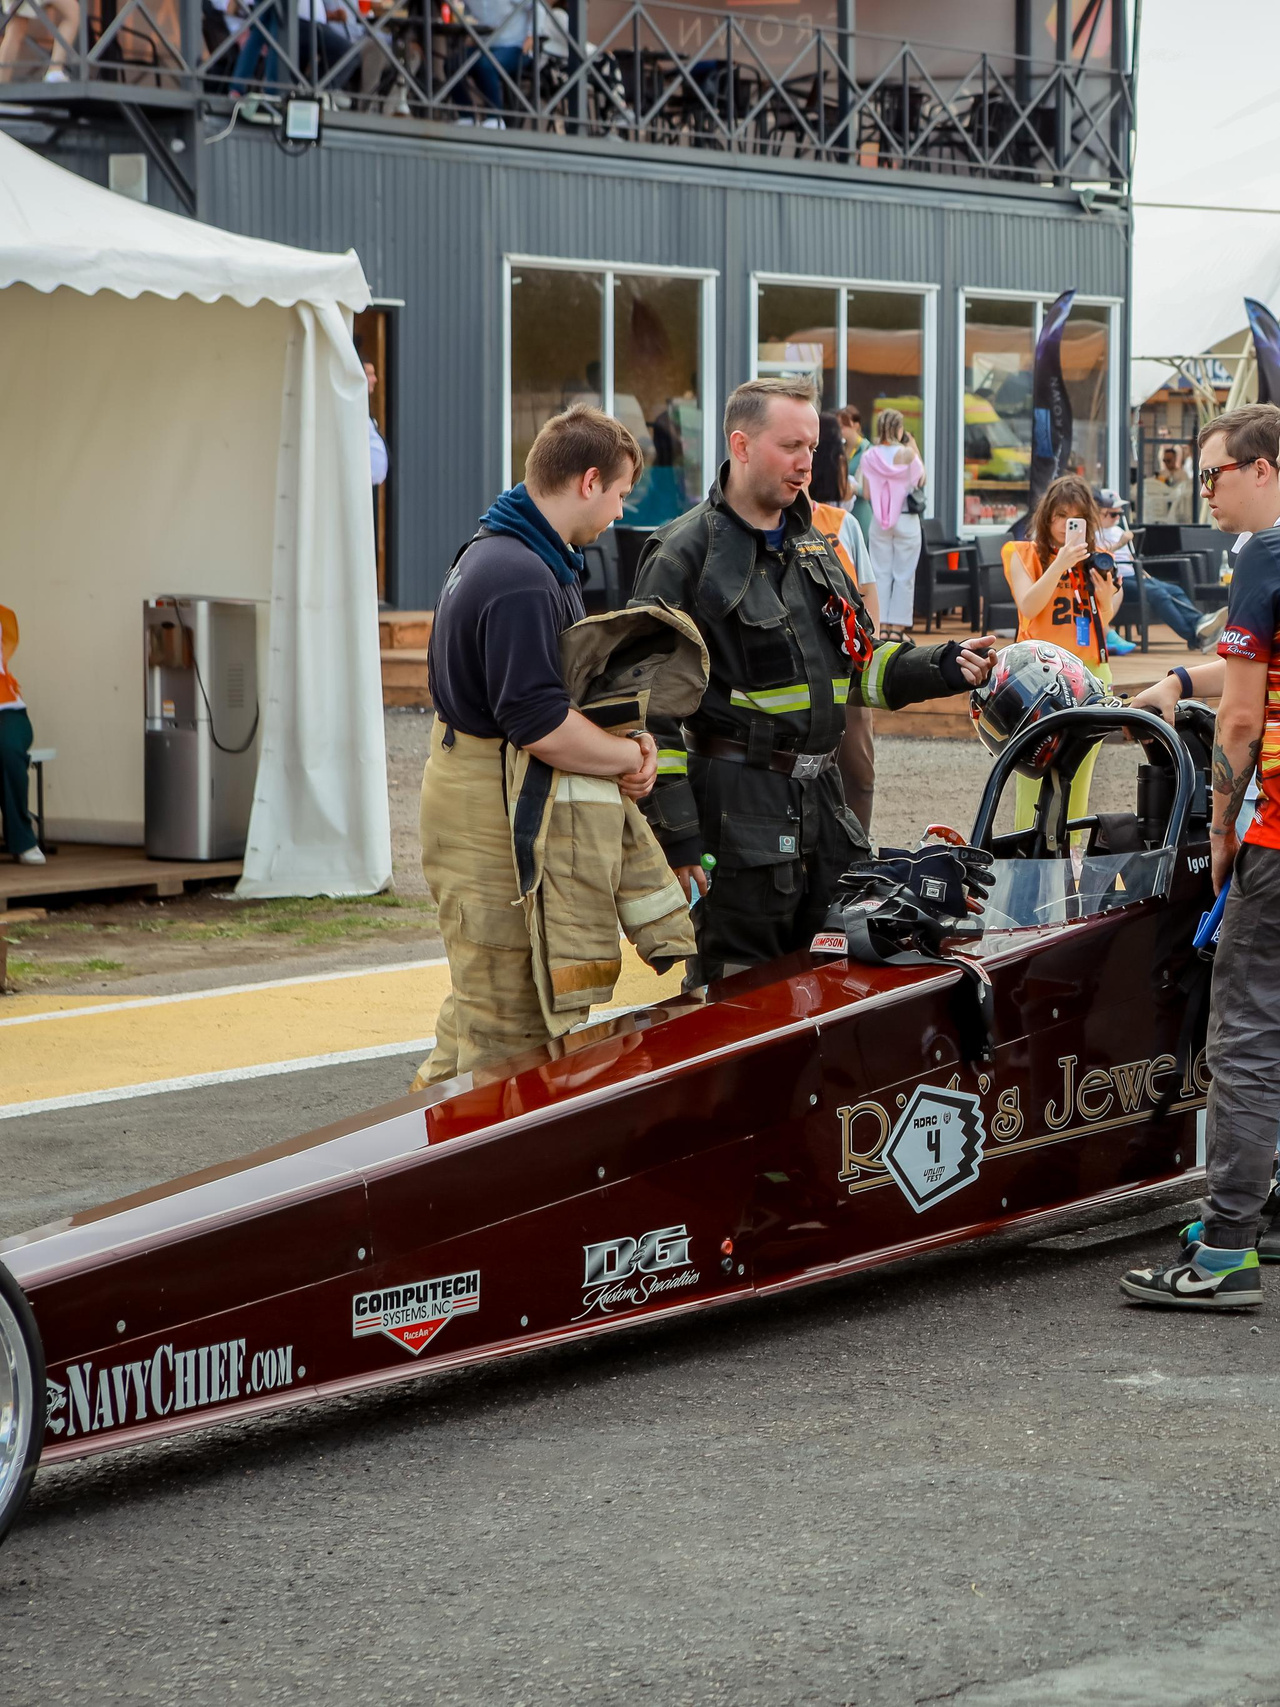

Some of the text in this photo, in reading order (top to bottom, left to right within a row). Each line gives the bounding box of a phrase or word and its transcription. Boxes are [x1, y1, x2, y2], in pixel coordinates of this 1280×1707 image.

[1187, 855, 1210, 874] Igor
[813, 936, 844, 949] SIMPSON
[913, 1115, 938, 1129] RDRC
[926, 1129, 941, 1164] 4
[926, 1174, 943, 1183] FEST
[355, 1274, 478, 1317] COMPUTECH
[631, 1269, 700, 1305] Specialties
[382, 1300, 454, 1327] SYSTEMS, INC.
